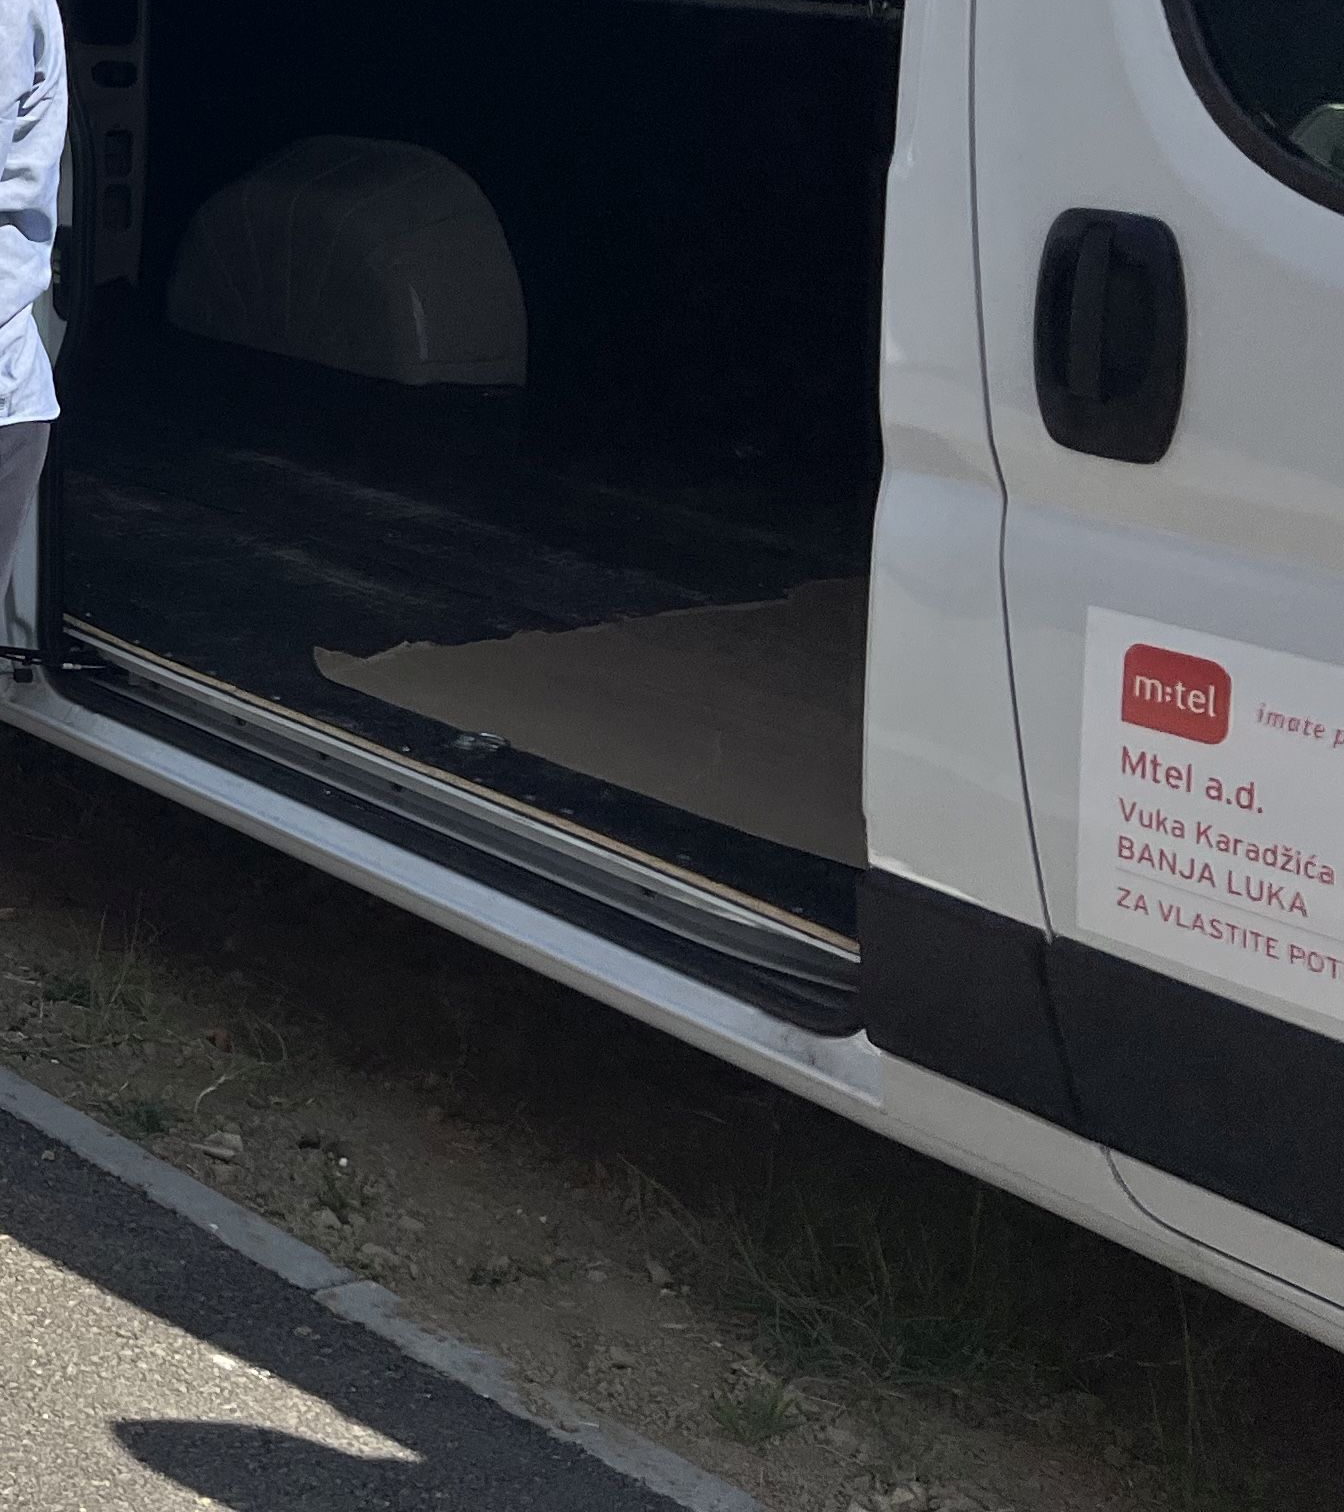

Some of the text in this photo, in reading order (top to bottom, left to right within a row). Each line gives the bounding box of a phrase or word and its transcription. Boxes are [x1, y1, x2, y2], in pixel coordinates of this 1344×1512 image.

[1135, 675, 1216, 717] m:tel
[1256, 701, 1326, 739] imate
[1121, 745, 1264, 814] Mtel a.d.
[1118, 796, 1336, 886] Vuka Karadžića
[1118, 835, 1309, 918] BANJA LUKA
[1116, 886, 1150, 915] ZA
[1158, 900, 1280, 960] VLASTITE
